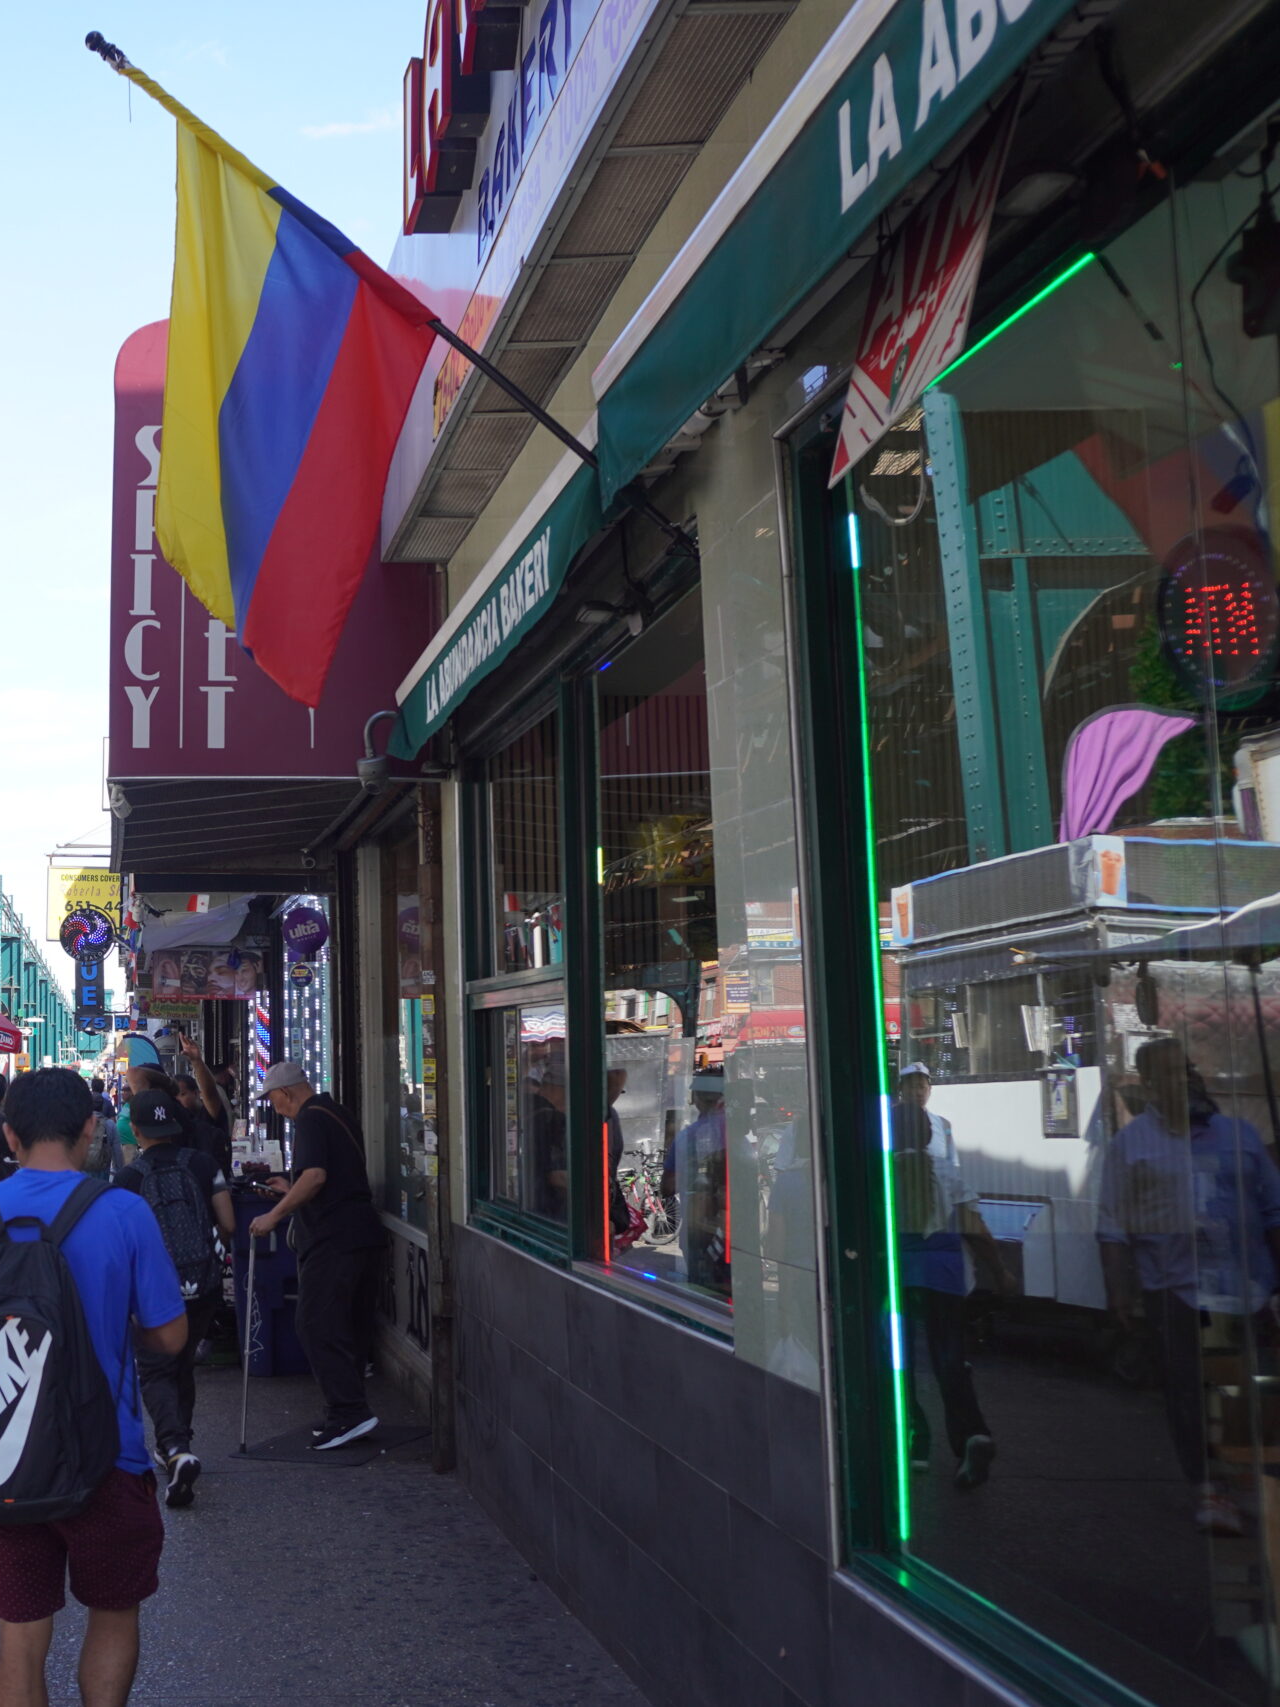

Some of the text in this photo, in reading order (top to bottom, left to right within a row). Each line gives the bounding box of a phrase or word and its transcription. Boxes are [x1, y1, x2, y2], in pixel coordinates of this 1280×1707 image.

[477, 0, 571, 266] BAKERY
[838, 0, 1028, 215] LA AB
[426, 526, 550, 724] LA ABUNDANCIA BAKERY
[61, 874, 99, 882] CONSUMERS
[289, 920, 320, 939] ultra
[80, 1017, 106, 1029] 75
